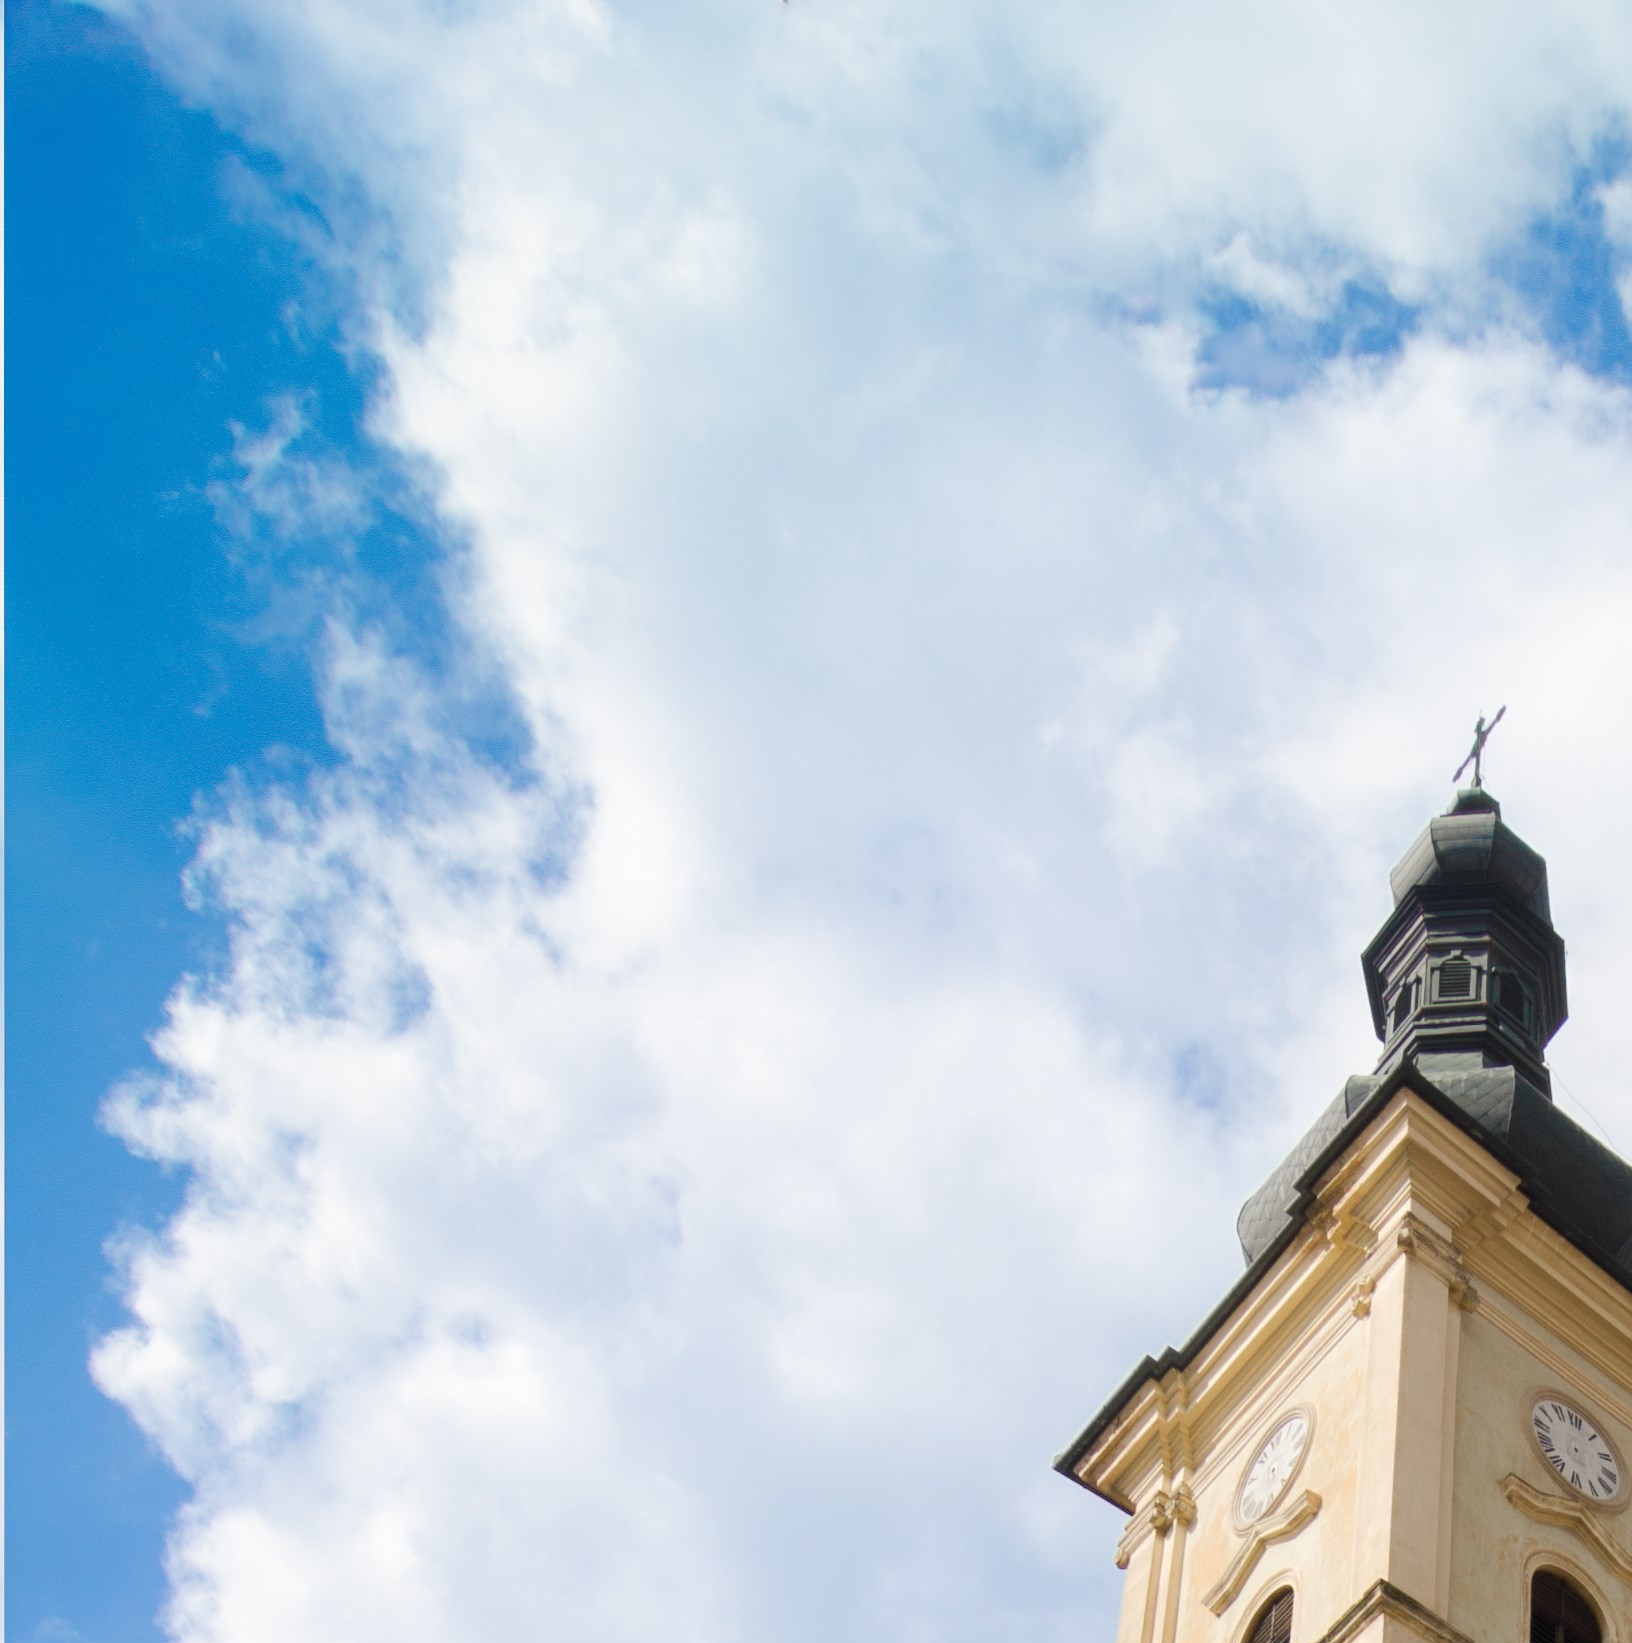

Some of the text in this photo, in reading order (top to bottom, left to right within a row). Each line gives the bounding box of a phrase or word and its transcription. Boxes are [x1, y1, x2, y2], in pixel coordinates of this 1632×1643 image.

[1539, 1405, 1553, 1423] X
[1551, 1403, 1566, 1423] XI
[1567, 1409, 1582, 1432] XII
[1588, 1433, 1597, 1441] I
[1598, 1451, 1613, 1463] II
[1571, 1470, 1582, 1489] VI
[1588, 1479, 1599, 1498] V
